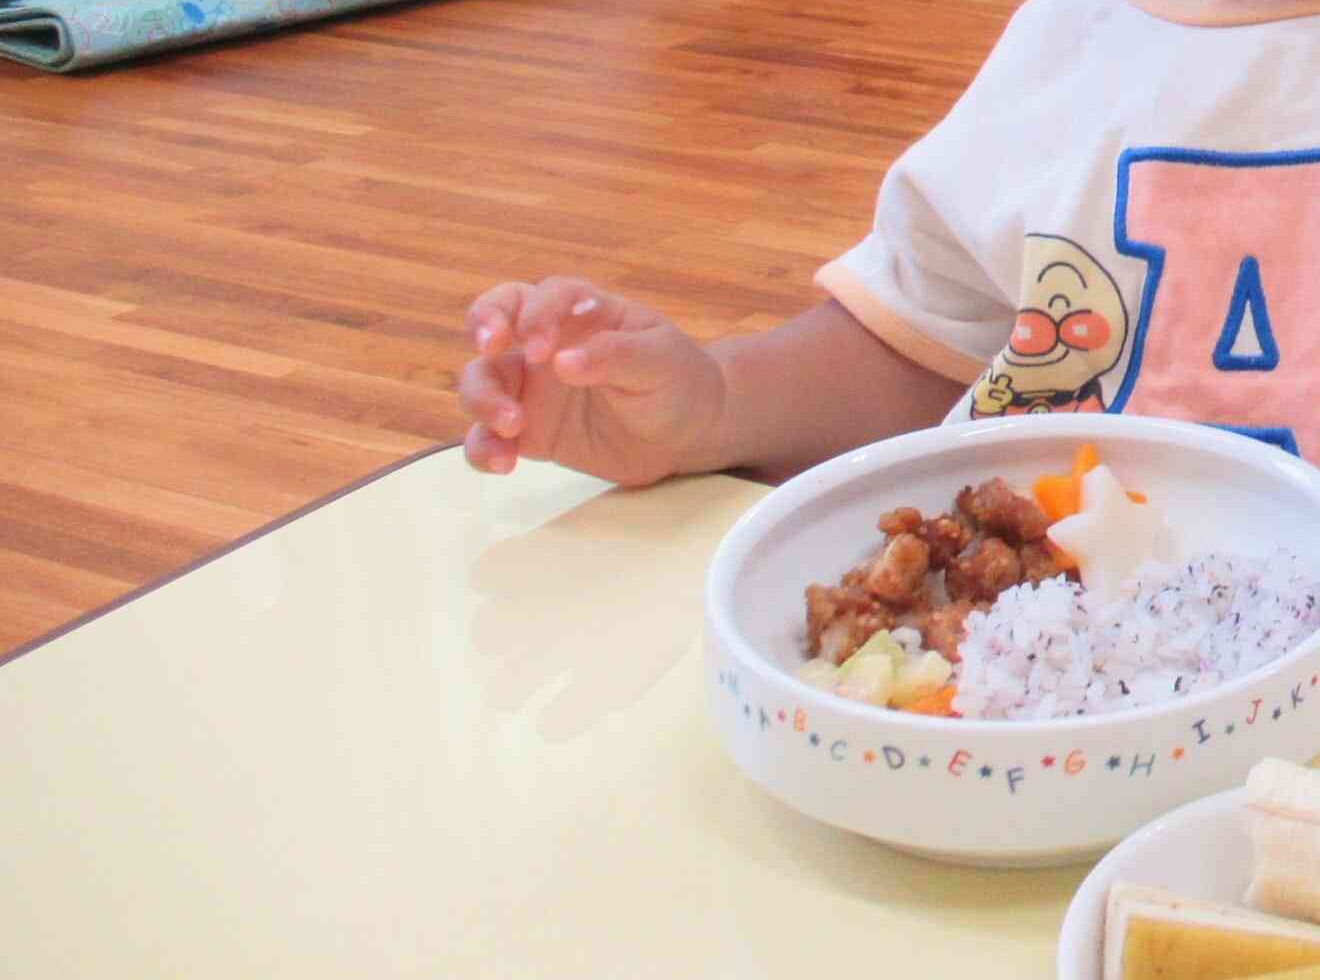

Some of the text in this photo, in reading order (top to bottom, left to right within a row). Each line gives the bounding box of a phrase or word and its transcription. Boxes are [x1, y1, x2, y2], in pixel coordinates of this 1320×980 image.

[792, 708, 809, 732] B
[829, 739, 848, 761] C
[882, 745, 905, 769] D
[947, 749, 973, 777] E
[1006, 766, 1025, 795] F
[1063, 749, 1088, 776] G
[1128, 752, 1157, 778] H
[1191, 718, 1212, 744] I
[1246, 697, 1264, 725] J
[1290, 682, 1305, 709] K
